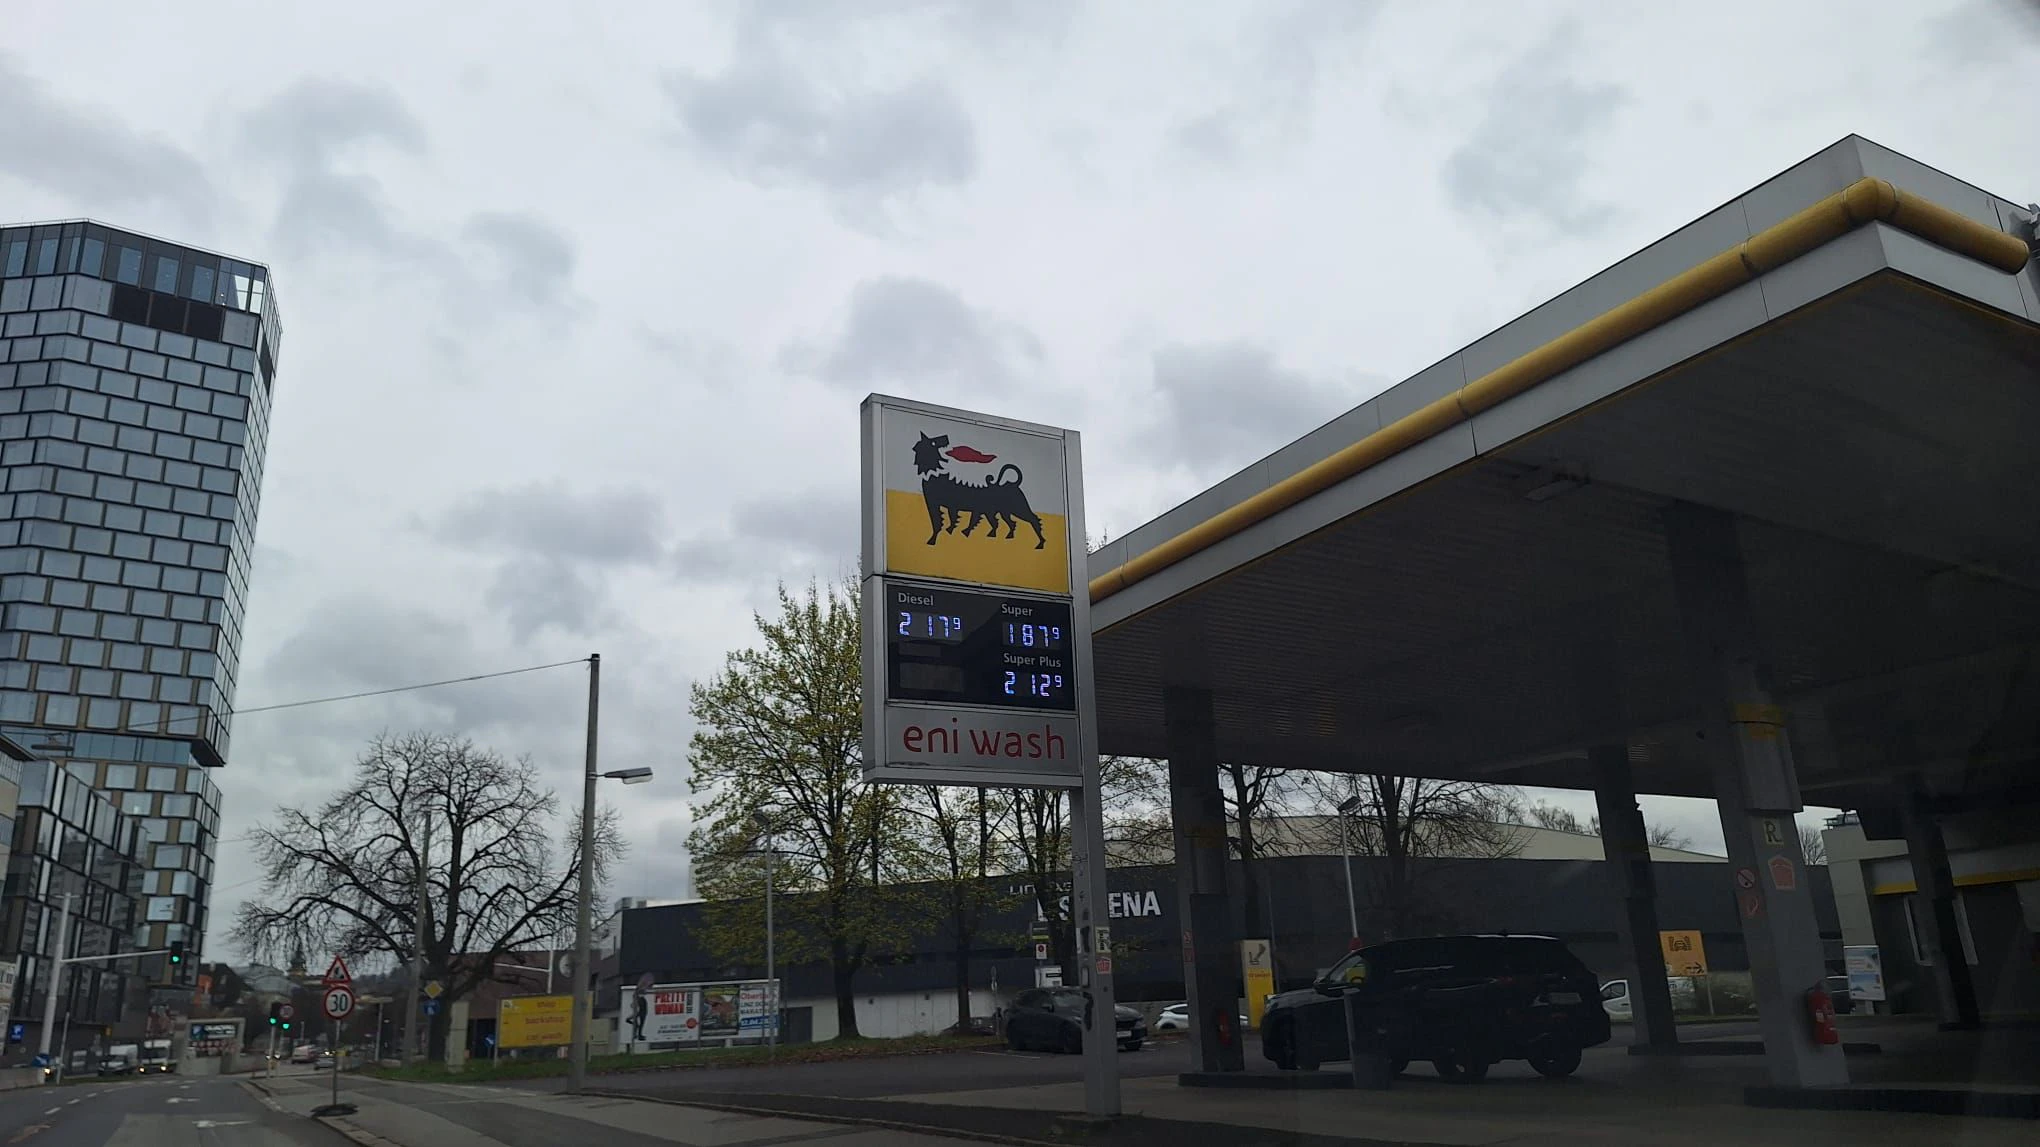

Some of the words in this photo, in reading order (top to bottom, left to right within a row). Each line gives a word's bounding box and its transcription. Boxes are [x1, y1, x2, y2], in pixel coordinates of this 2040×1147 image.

[898, 592, 934, 606] Diesel
[1001, 603, 1033, 617] Super
[1003, 653, 1036, 667] Super
[1039, 656, 1062, 668] Plus
[903, 717, 959, 754] eni
[969, 724, 1064, 760] wash
[1764, 820, 1783, 842] R
[330, 993, 348, 1012] 30
